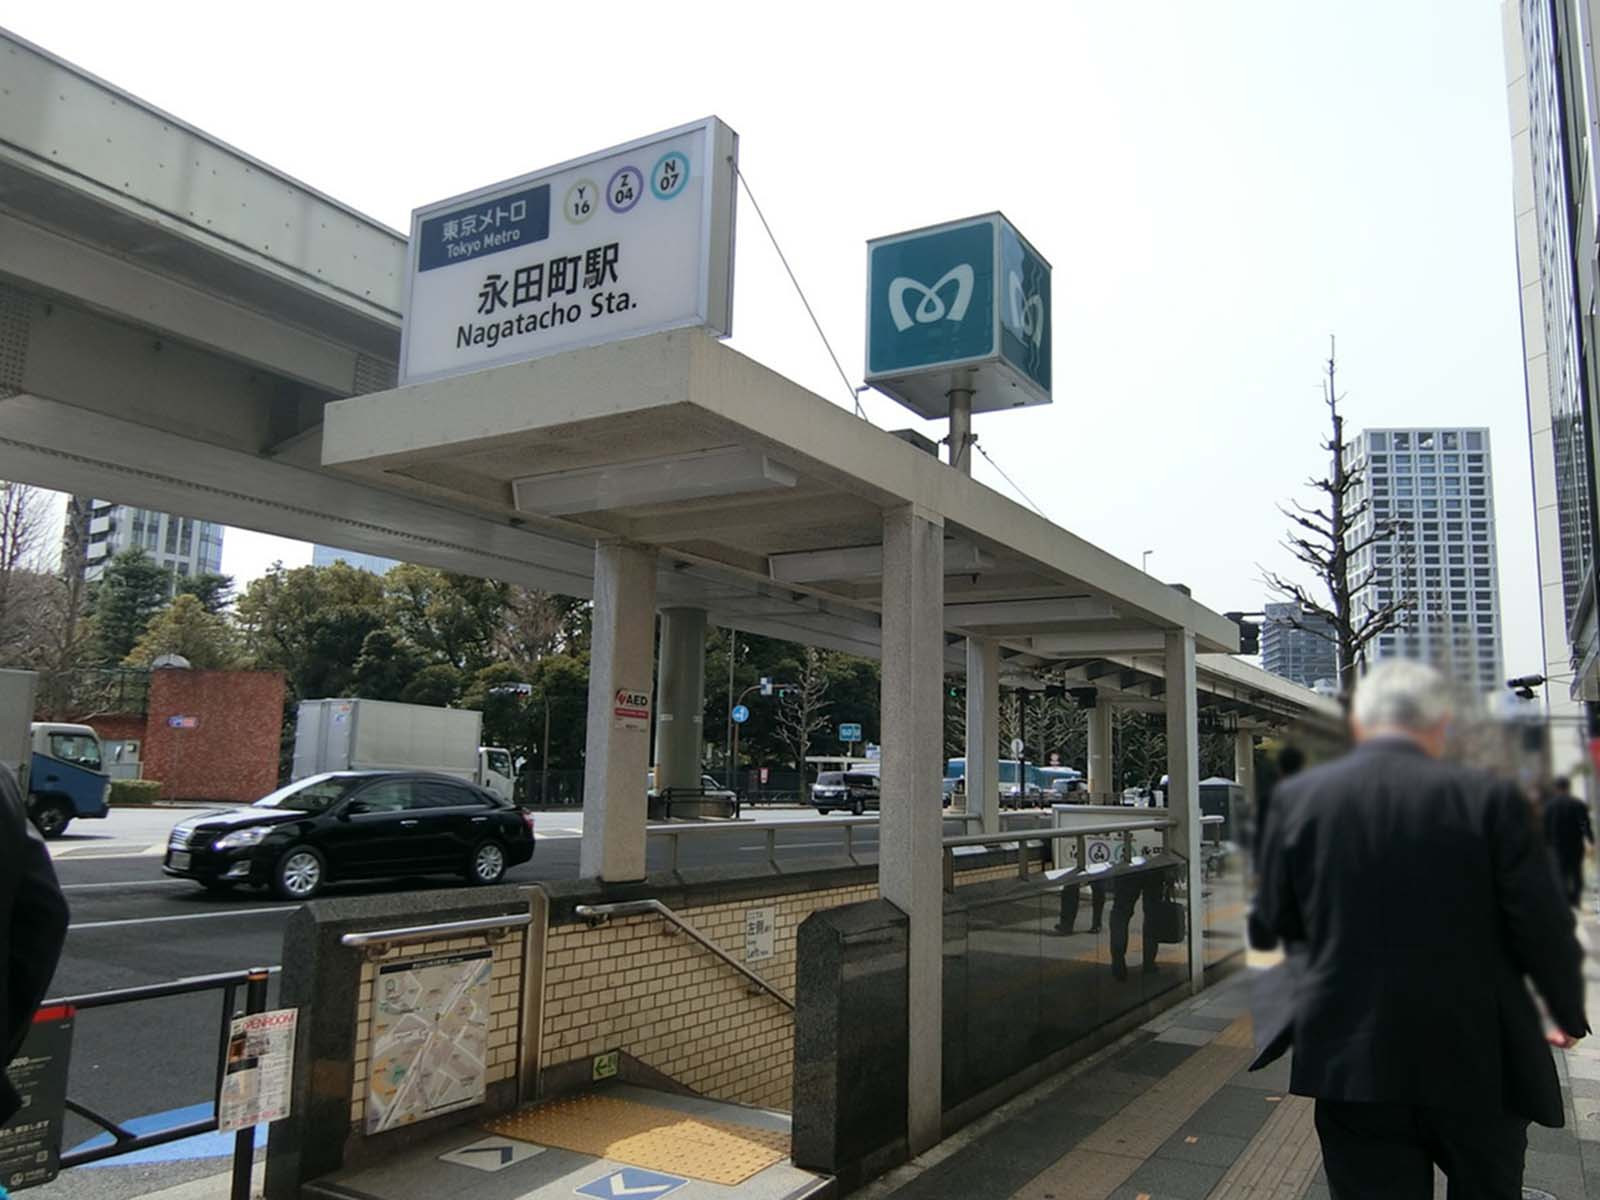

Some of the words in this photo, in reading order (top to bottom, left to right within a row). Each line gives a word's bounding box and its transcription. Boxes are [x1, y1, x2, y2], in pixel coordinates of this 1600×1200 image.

[664, 160, 676, 174] N
[620, 173, 630, 188] Z
[660, 173, 680, 191] 07
[576, 186, 586, 199] Y
[615, 187, 633, 204] 04
[574, 200, 591, 216] 16
[441, 200, 526, 242] 東京メトロ
[446, 240, 481, 258] Tokyo
[483, 229, 521, 249] Metro
[477, 242, 619, 315] 永田町駅
[456, 302, 582, 348] Nagatacho
[590, 291, 638, 318] Sta.
[626, 694, 648, 706] AED
